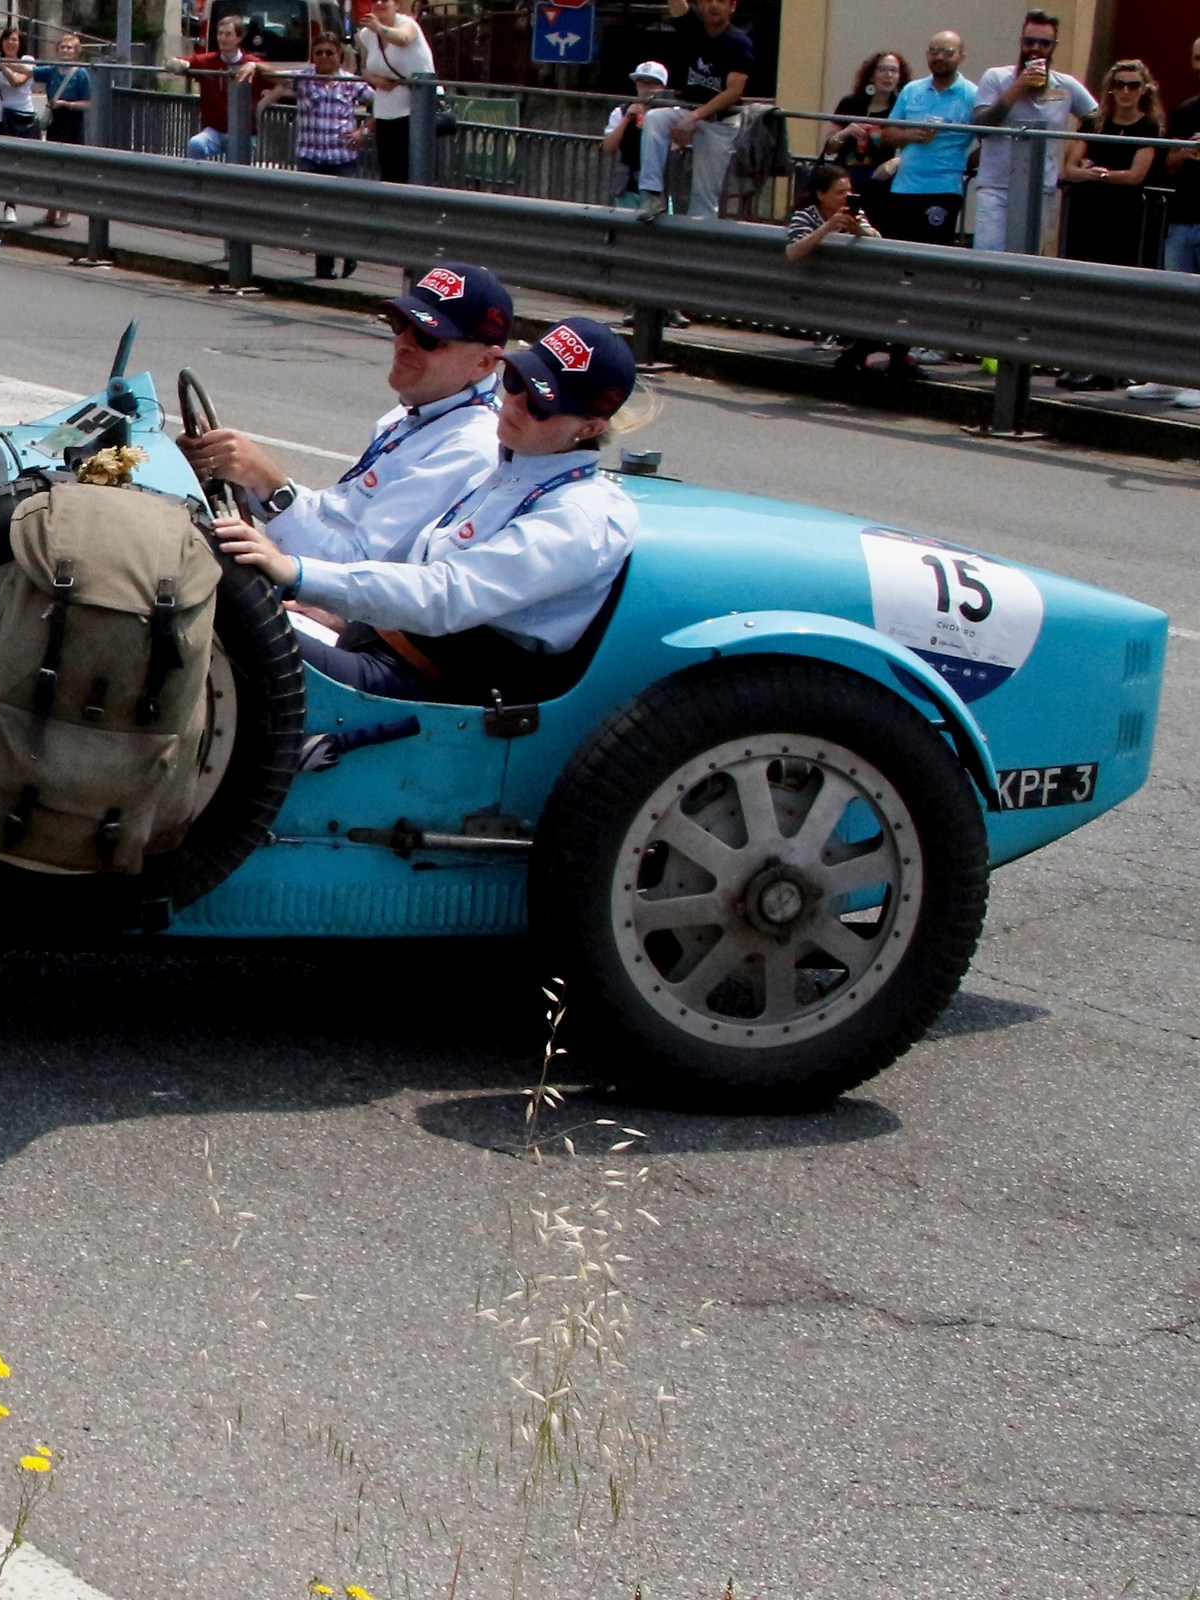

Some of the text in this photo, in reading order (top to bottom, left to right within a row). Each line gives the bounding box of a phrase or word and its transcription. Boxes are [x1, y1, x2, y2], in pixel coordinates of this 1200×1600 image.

[557, 330, 583, 354] 1000
[921, 554, 993, 623] 15
[936, 621, 976, 638] CHOPRD
[997, 764, 1093, 809] KPF 3
